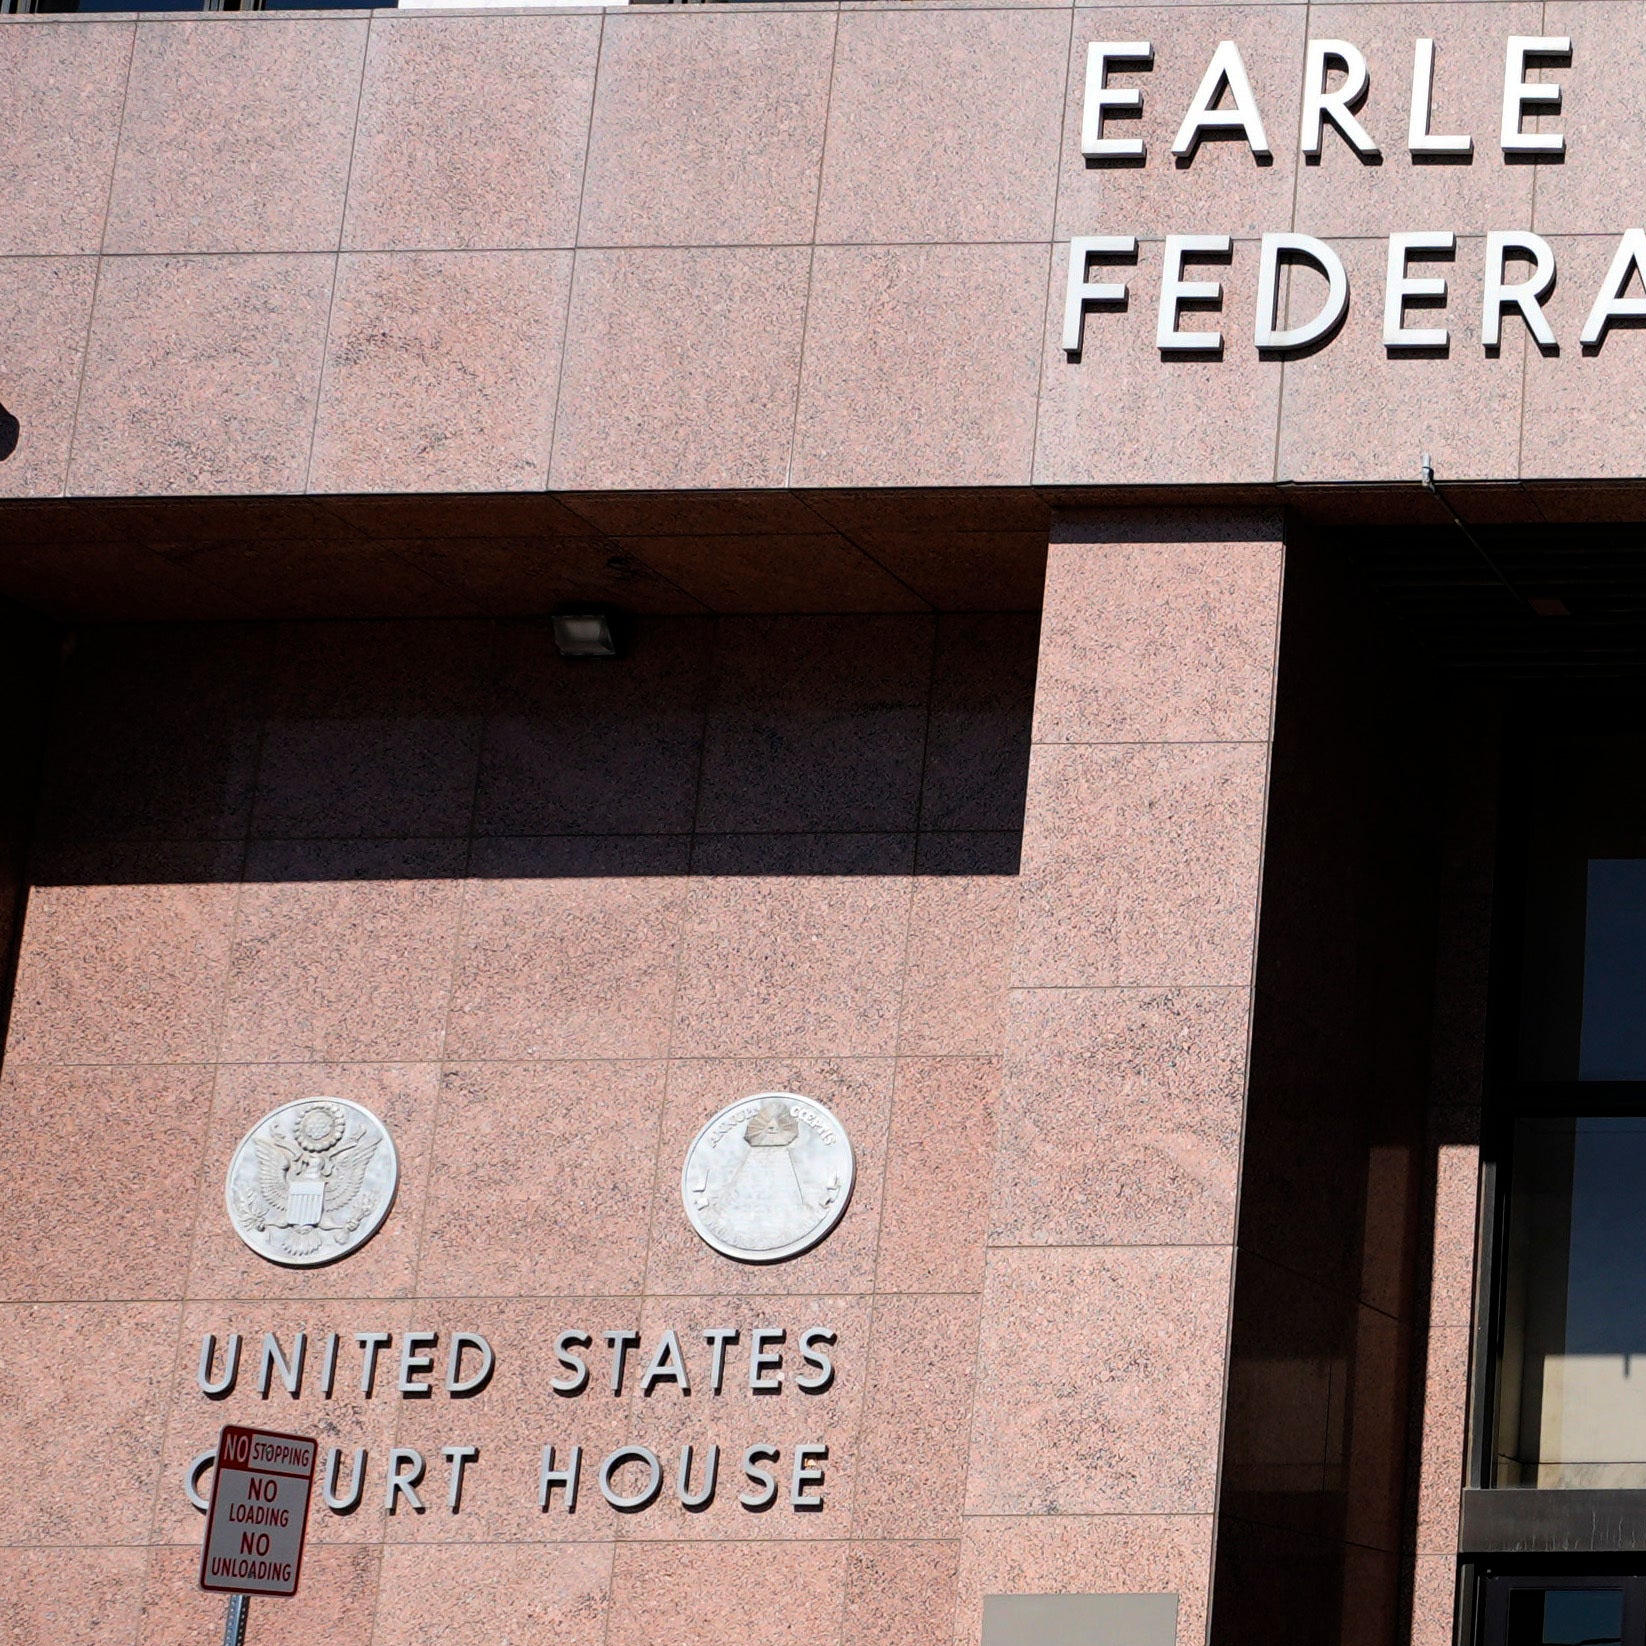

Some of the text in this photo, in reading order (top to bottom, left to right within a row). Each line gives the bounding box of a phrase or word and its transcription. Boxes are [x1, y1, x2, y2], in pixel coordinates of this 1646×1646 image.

[1081, 36, 1574, 160] EARLE
[197, 1327, 836, 1398] UNITED STATES
[223, 1433, 310, 1467] NO STOPPING
[184, 1444, 829, 1512] CURT HOUSE
[248, 1477, 278, 1503] NO
[229, 1503, 289, 1528] LOADING
[240, 1531, 270, 1557] NO
[211, 1557, 292, 1582] UNLOADING
